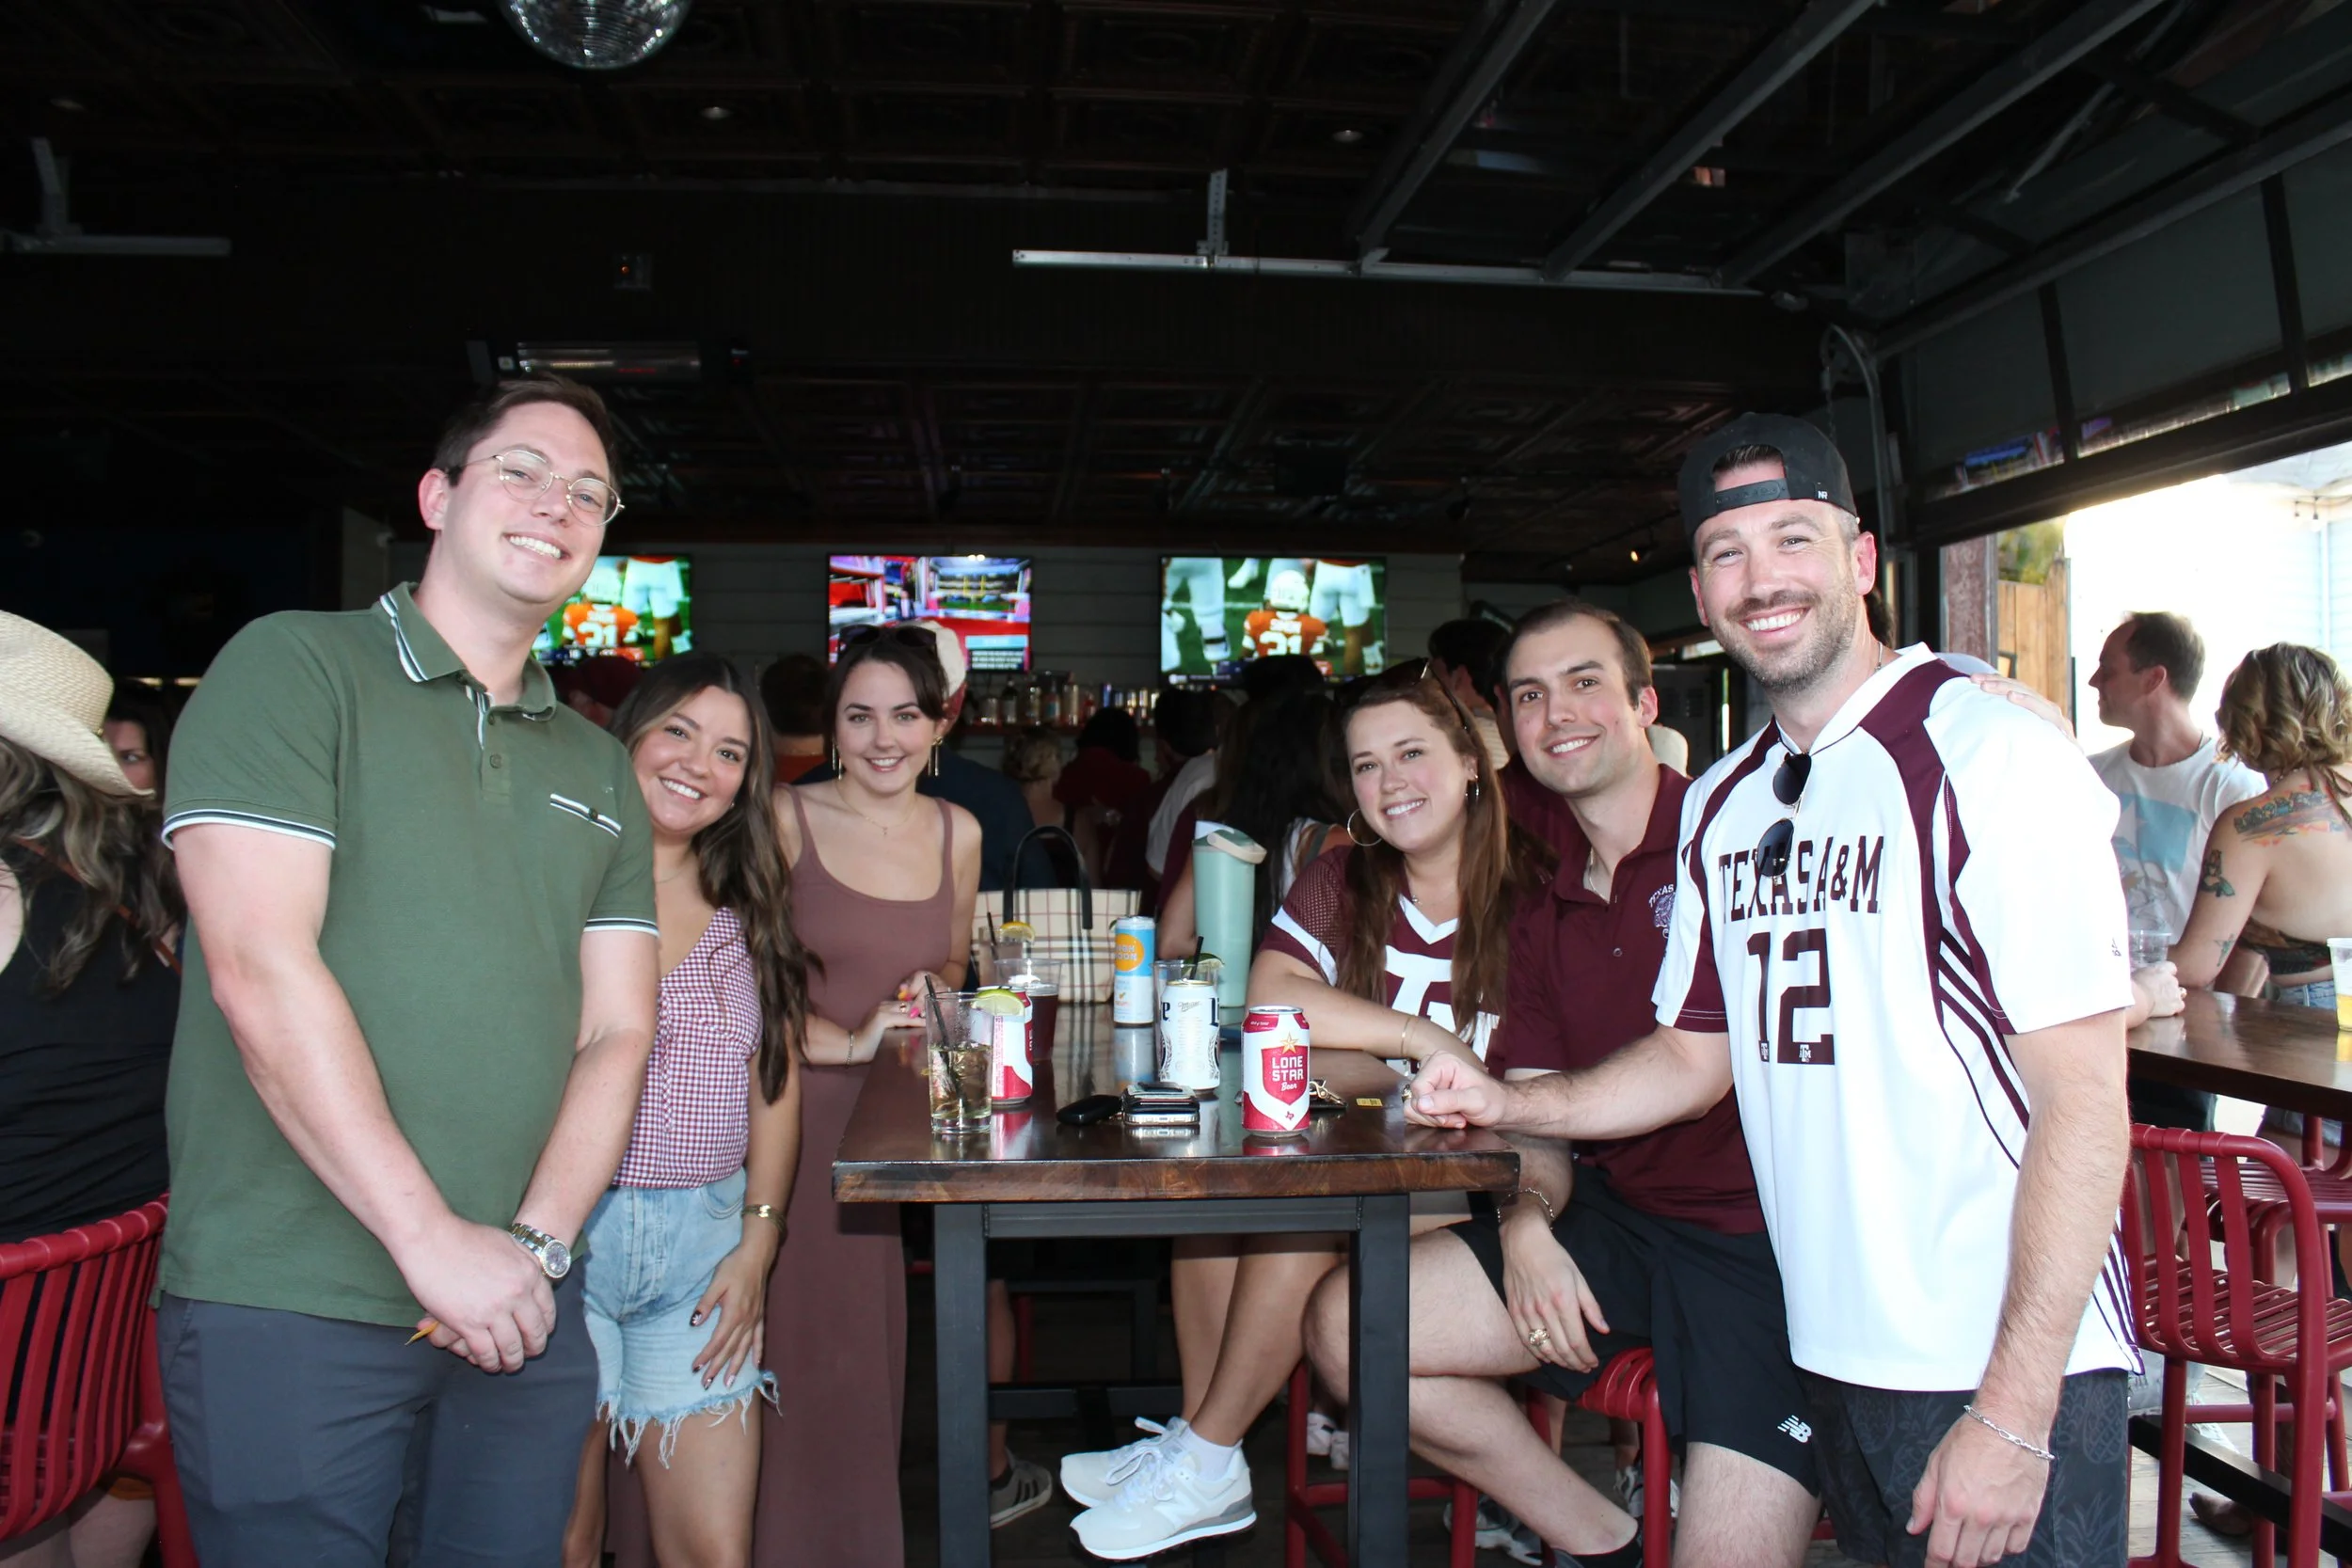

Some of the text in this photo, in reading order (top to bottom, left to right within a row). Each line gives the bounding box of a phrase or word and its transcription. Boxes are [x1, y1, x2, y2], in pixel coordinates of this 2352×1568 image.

[1813, 835, 1884, 914] A&M
[1648, 884, 1675, 908] TEXAS
[1746, 927, 1836, 1066] 12
[1271, 1055, 1303, 1069] LONE
[1271, 1069, 1305, 1082] STAR
[1280, 1081, 1297, 1091] Beer
